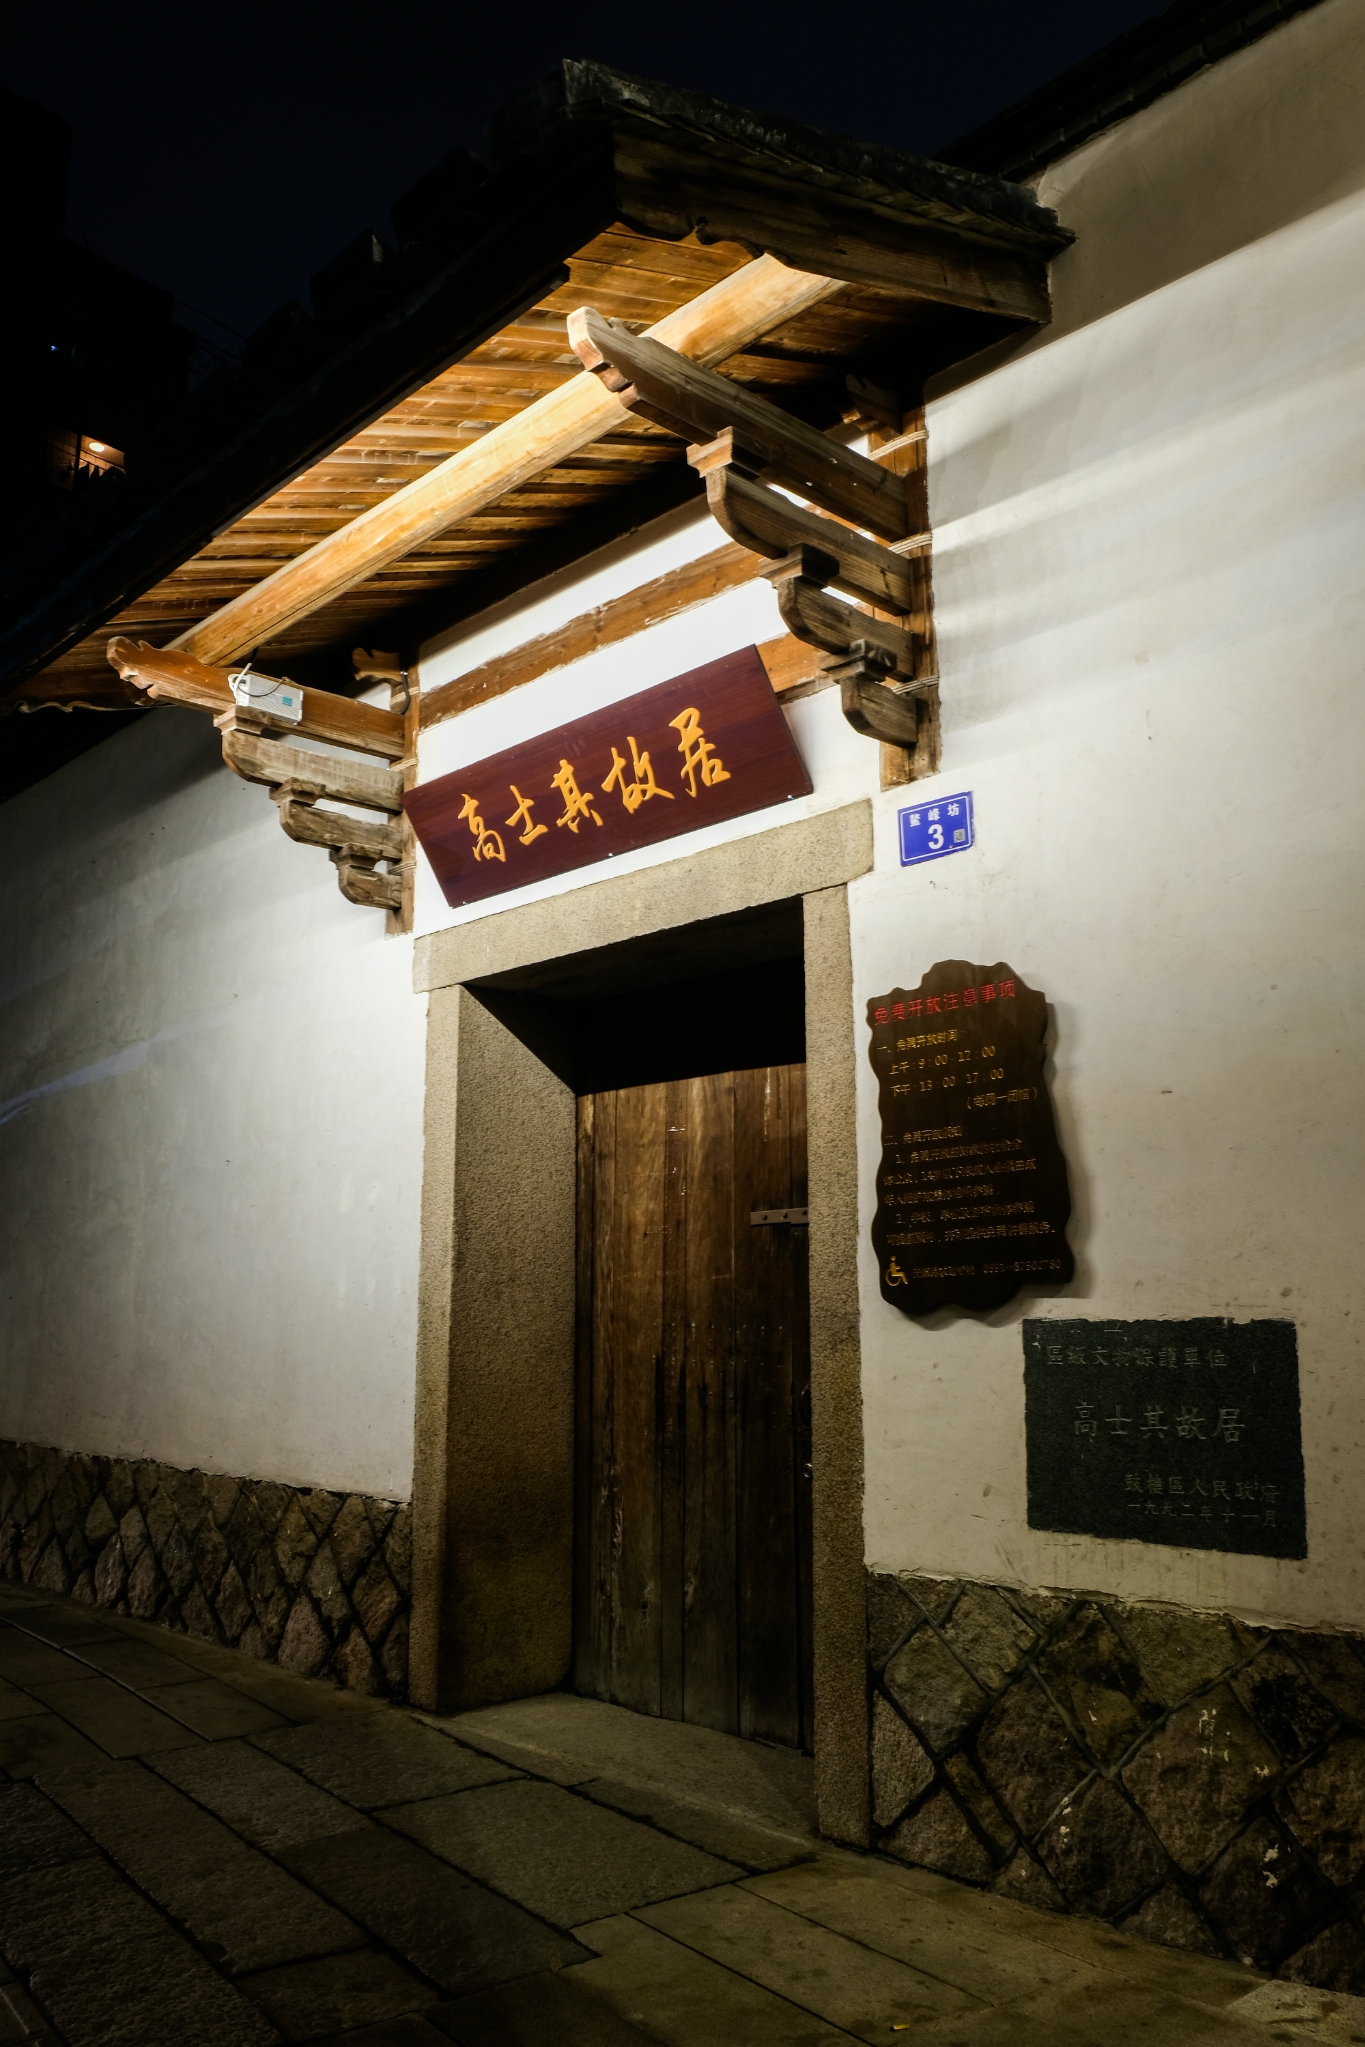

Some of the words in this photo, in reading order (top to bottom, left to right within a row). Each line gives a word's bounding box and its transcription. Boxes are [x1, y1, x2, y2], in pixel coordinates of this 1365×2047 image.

[458, 707, 731, 863] 高士其故居
[928, 824, 945, 850] 3
[874, 979, 1016, 1025] 免费开放注意事项
[1074, 1400, 1245, 1443] 高士其故居
